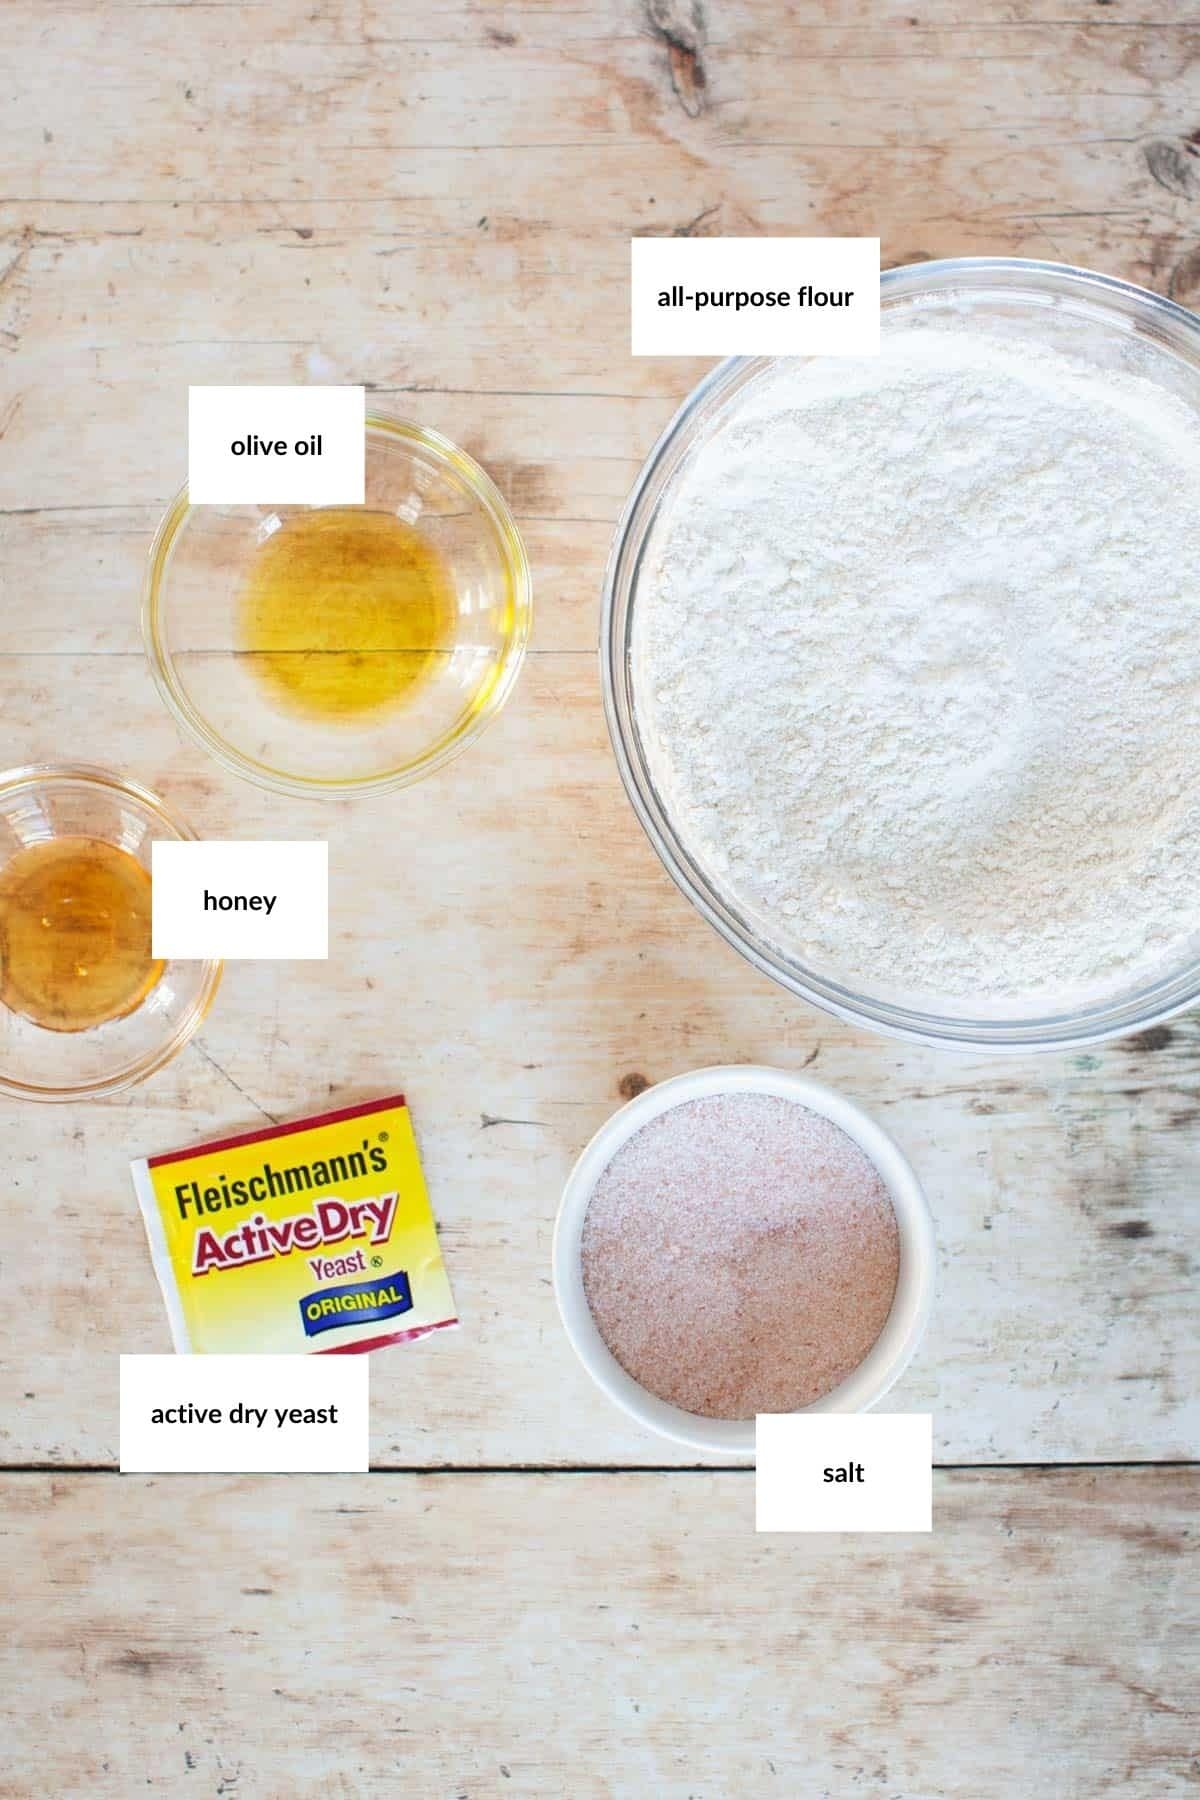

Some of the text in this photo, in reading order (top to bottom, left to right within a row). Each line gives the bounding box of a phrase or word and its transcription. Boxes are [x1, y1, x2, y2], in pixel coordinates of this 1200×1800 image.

[174, 1139, 388, 1220] Fleischmann's
[309, 1249, 367, 1281] Yeast
[305, 1286, 403, 1321] ORIGINAL
